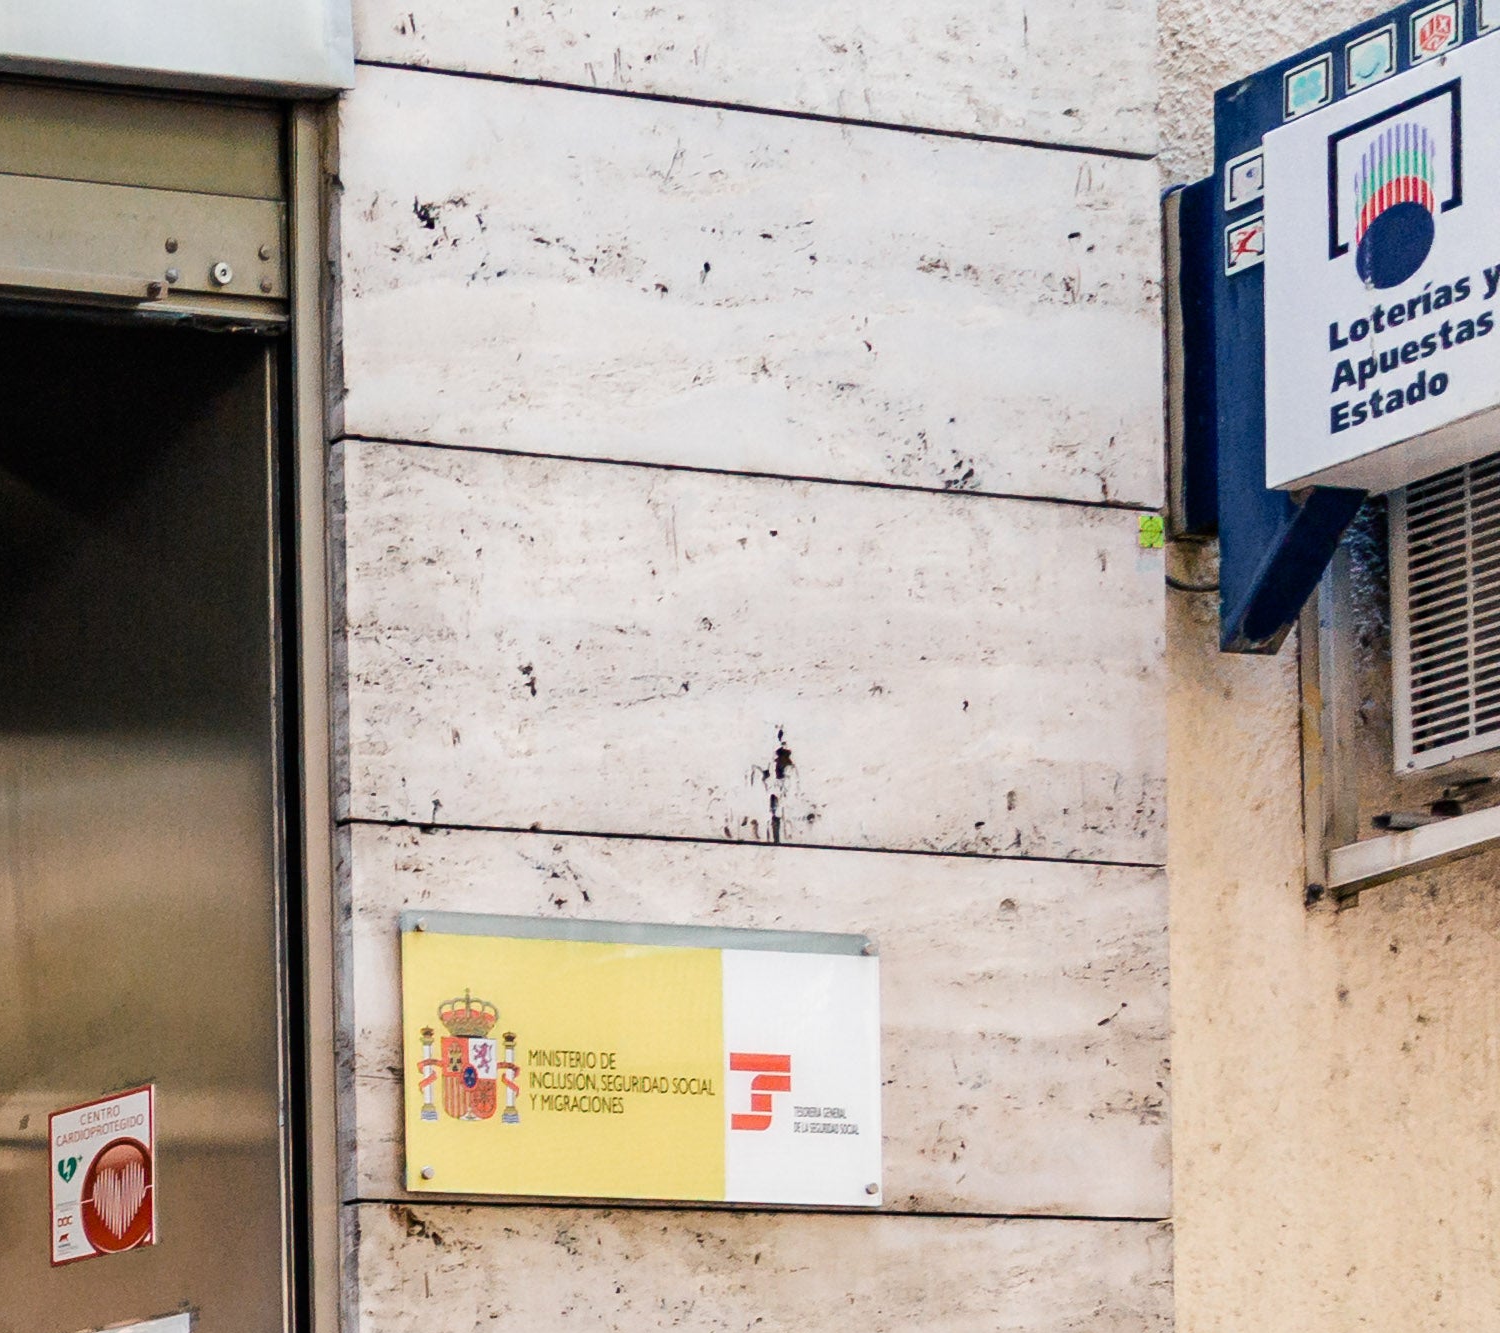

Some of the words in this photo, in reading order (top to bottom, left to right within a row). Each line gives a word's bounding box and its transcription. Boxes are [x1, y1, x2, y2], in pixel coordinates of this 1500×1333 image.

[1329, 276, 1471, 351] Loterías
[1482, 263, 1500, 300] y
[1331, 310, 1494, 393] Apuestas
[1331, 369, 1449, 434] Estado
[528, 1049, 596, 1069] MINISTERIO
[600, 1052, 616, 1070] DE
[529, 1068, 599, 1092] INCLUSIÓN,
[601, 1074, 669, 1094] SEGURIDAD
[672, 1077, 715, 1096] SOCIAL
[80, 1105, 120, 1125] CENTRO
[530, 1094, 538, 1111] Y
[541, 1095, 624, 1113] MIGRACIONES
[56, 1113, 144, 1147] CARDIOPROTEGIDO
